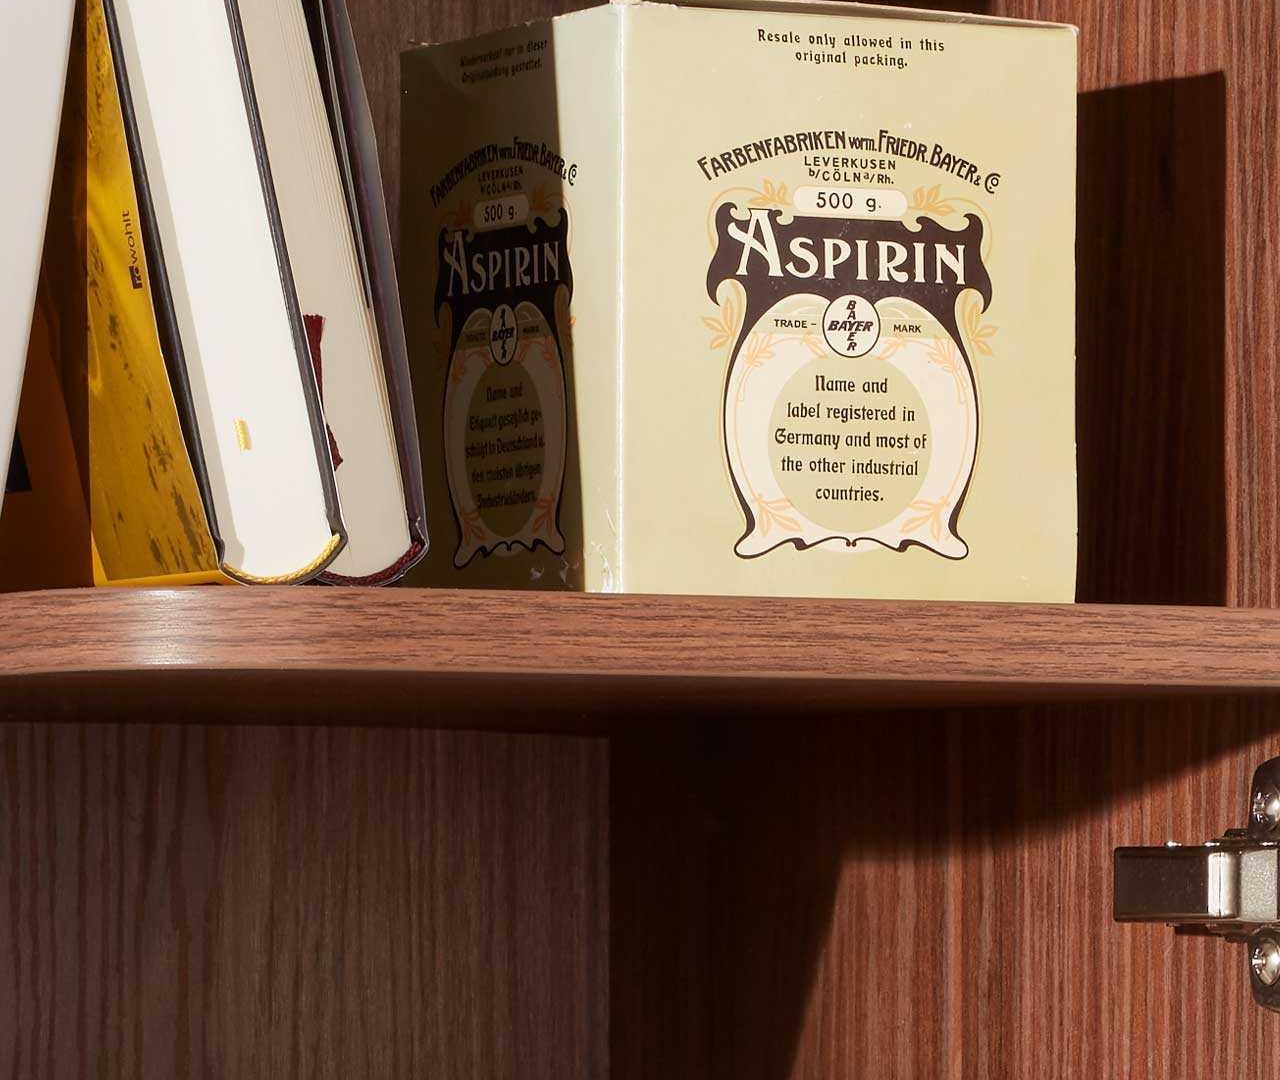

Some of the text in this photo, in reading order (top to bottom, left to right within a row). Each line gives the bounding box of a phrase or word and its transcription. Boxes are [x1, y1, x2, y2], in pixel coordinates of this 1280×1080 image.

[757, 29, 945, 52] Resale only allowed in this
[795, 50, 908, 69] original packing.
[696, 130, 847, 182] FARBENFABRIKEN
[804, 155, 896, 170] LEVERKUSEN
[816, 191, 882, 213] 500 g.
[484, 203, 503, 222] 500
[727, 208, 966, 286] ASPIRIN
[444, 231, 560, 297] ASPIRIN
[774, 318, 808, 329] TRADE
[893, 323, 922, 334] MARK
[827, 320, 874, 333] BAYER
[815, 375, 888, 394] Name and
[786, 402, 915, 424] label registered in
[774, 428, 927, 450] Germany and most of
[781, 456, 919, 476] the other industrial
[815, 486, 884, 502] countries.
